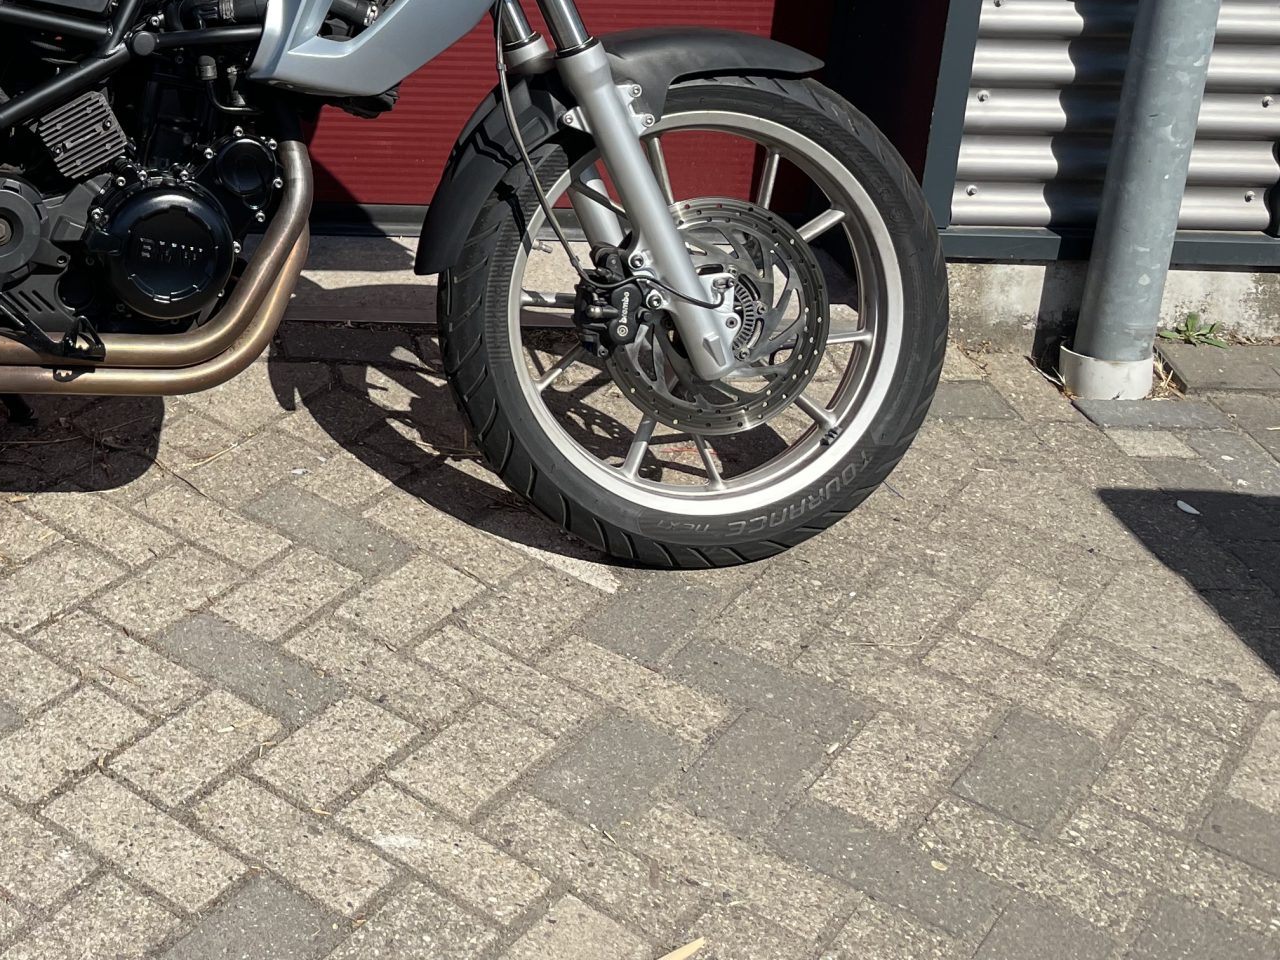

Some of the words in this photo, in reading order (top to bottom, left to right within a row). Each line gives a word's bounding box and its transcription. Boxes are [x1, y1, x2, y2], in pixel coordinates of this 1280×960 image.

[139, 238, 203, 264] BMW
[618, 291, 630, 324] brembo
[725, 448, 871, 538] TOURANCE
